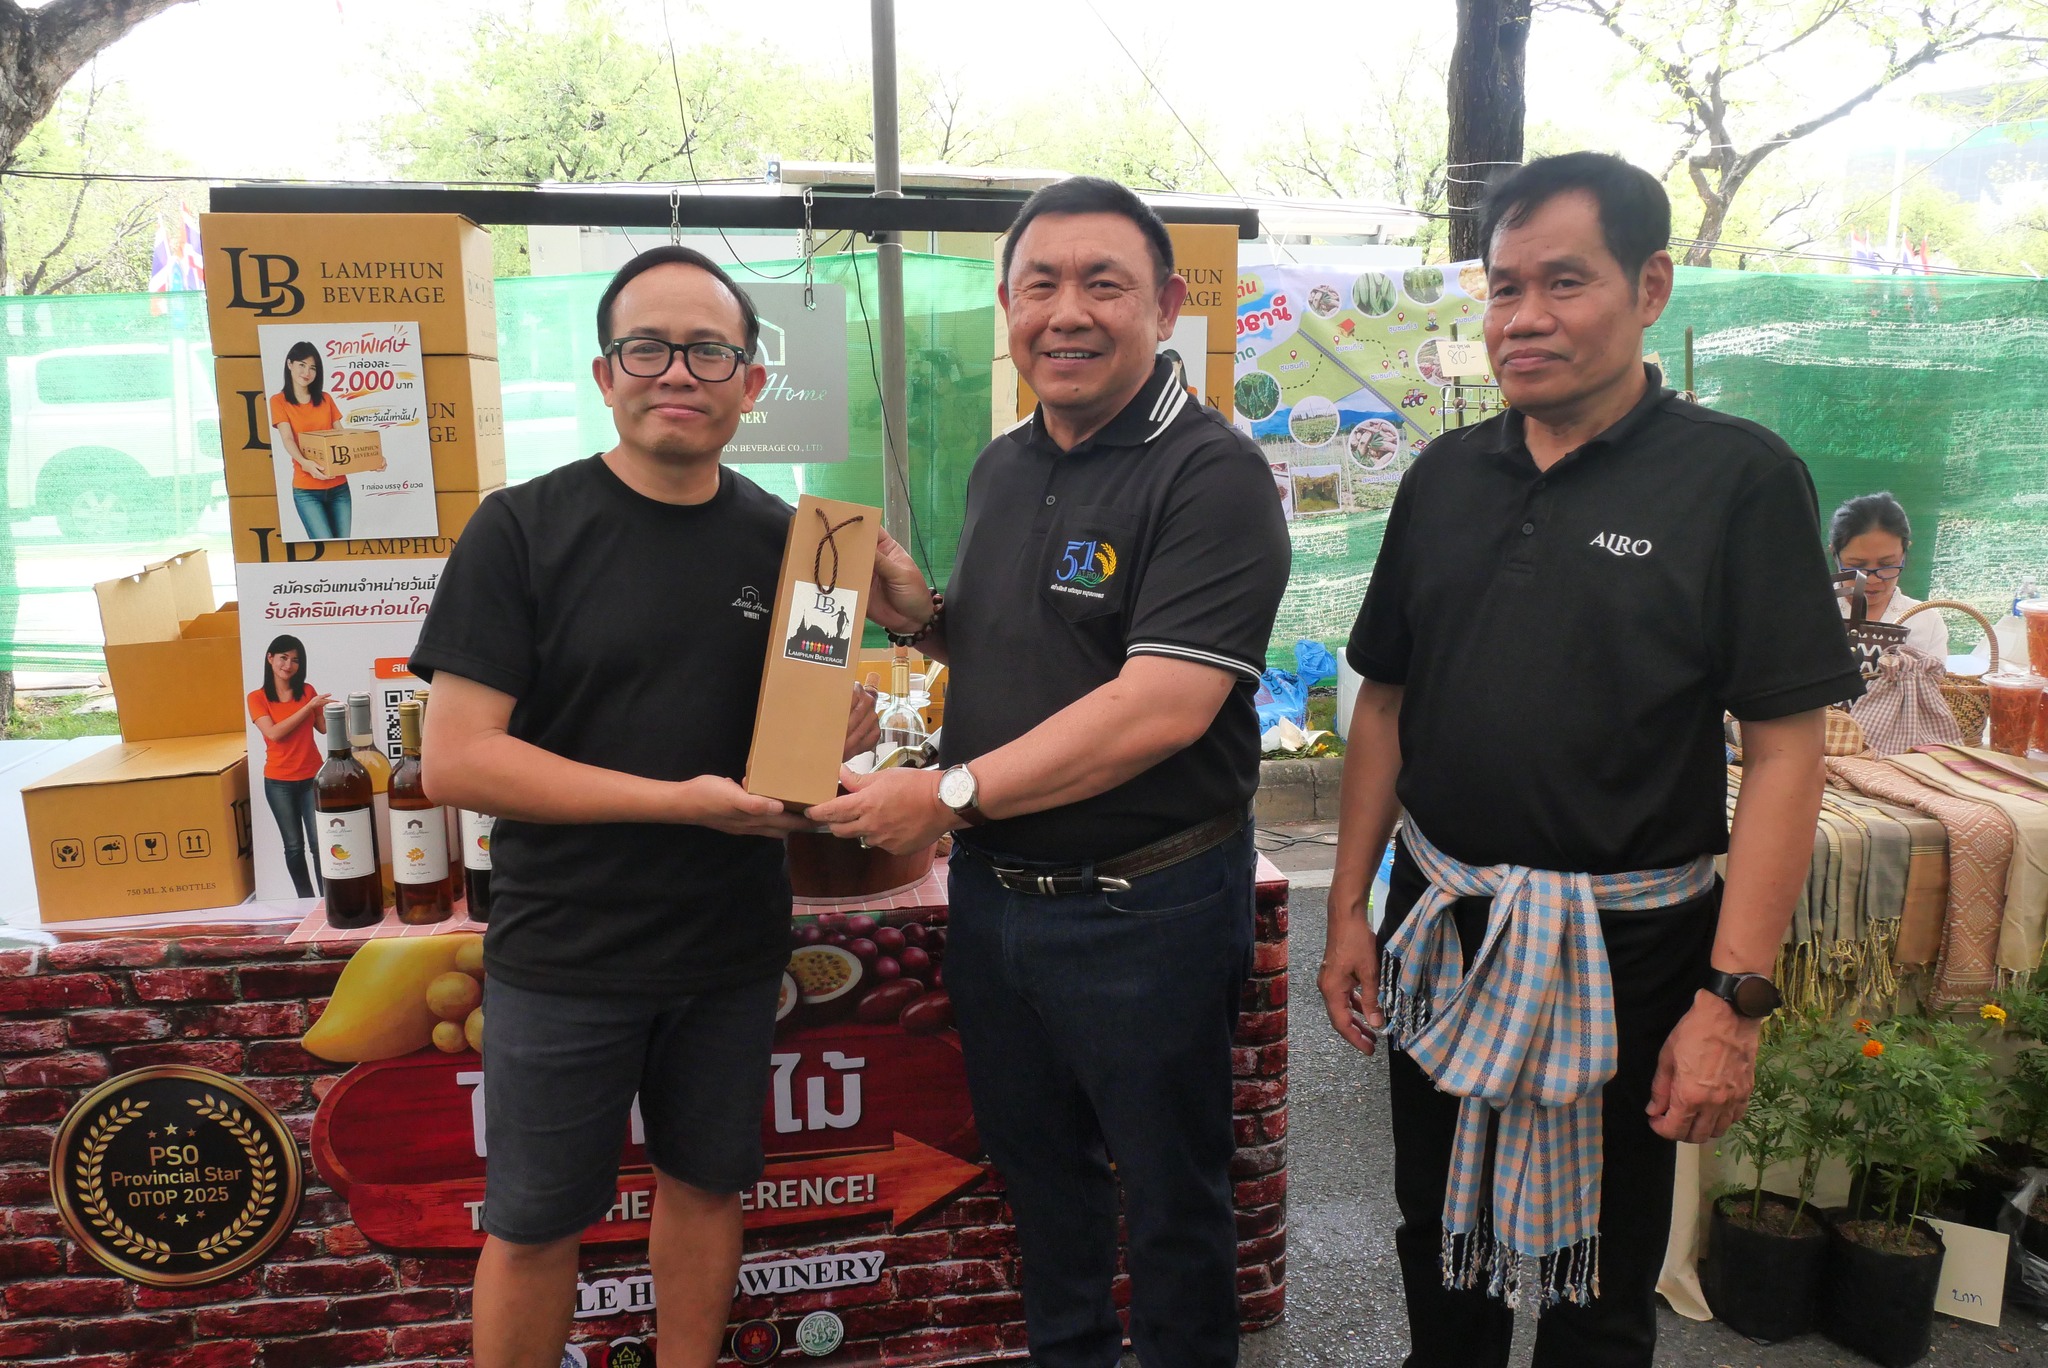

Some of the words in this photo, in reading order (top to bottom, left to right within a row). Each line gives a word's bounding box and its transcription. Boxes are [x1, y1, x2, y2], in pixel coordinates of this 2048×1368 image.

[320, 262, 445, 279] LAMPHUN
[221, 247, 305, 317] LB
[322, 287, 446, 304] BEVERAGE
[326, 332, 412, 358] ราคาพิเศษ
[348, 358, 390, 369] กล่องละ
[330, 370, 395, 394] 2,000
[395, 382, 413, 390] บาท
[755, 373, 828, 403] Home
[739, 411, 769, 424] NERY
[352, 445, 379, 453] LAMPHUN
[740, 444, 786, 452] BEVERAGE
[366, 481, 384, 491] กล่อง
[384, 483, 401, 491] บรรจุ
[402, 480, 408, 489] 6
[1589, 531, 1653, 556] ALRO
[1056, 541, 1097, 581] 51
[264, 595, 429, 620] รับสิทธิพิเศษก่อนใค
[176, 882, 217, 892] BOTTLES
[149, 1144, 200, 1167] PSO
[111, 1168, 201, 1188] Provincial
[204, 1166, 243, 1183] Star
[128, 1188, 179, 1208] OTOP
[184, 1186, 230, 1204] 2025
[606, 1190, 651, 1222] HE
[740, 1173, 876, 1212] ERENCE!
[743, 1255, 881, 1293] WINERY
